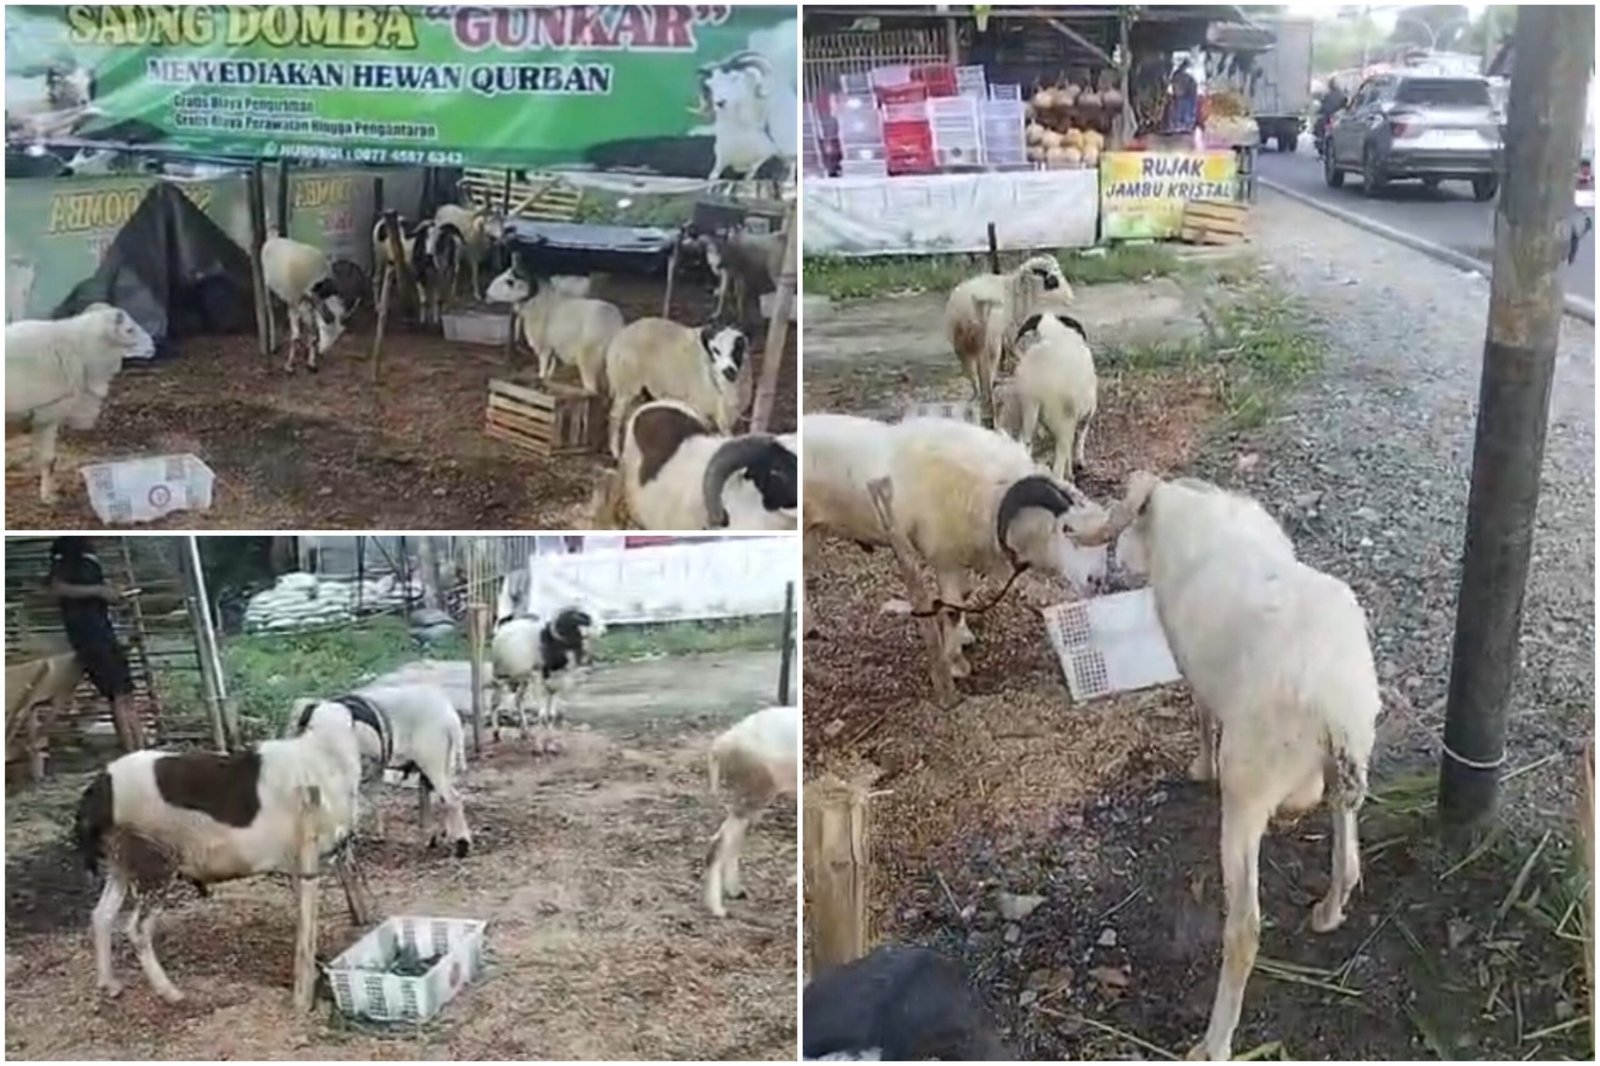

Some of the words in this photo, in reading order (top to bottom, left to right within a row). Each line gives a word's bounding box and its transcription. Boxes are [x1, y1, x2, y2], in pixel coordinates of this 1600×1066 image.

[69, 5, 214, 46] SAUNG
[226, 5, 418, 48] DOMBA
[148, 59, 344, 87] MENYEDIAKAN
[352, 64, 462, 89] HEWAN
[471, 65, 610, 93] QURBAN
[174, 94, 208, 108] Gratis
[211, 96, 242, 111] Biaya
[175, 113, 208, 127] Gratis
[245, 116, 309, 132] Perawatan
[311, 120, 351, 136] Hingga
[355, 121, 436, 138] Pengantaran
[1142, 157, 1204, 177] RUJAK
[1106, 181, 1163, 199] JAMBU
[1167, 182, 1231, 199] KRISTAL
